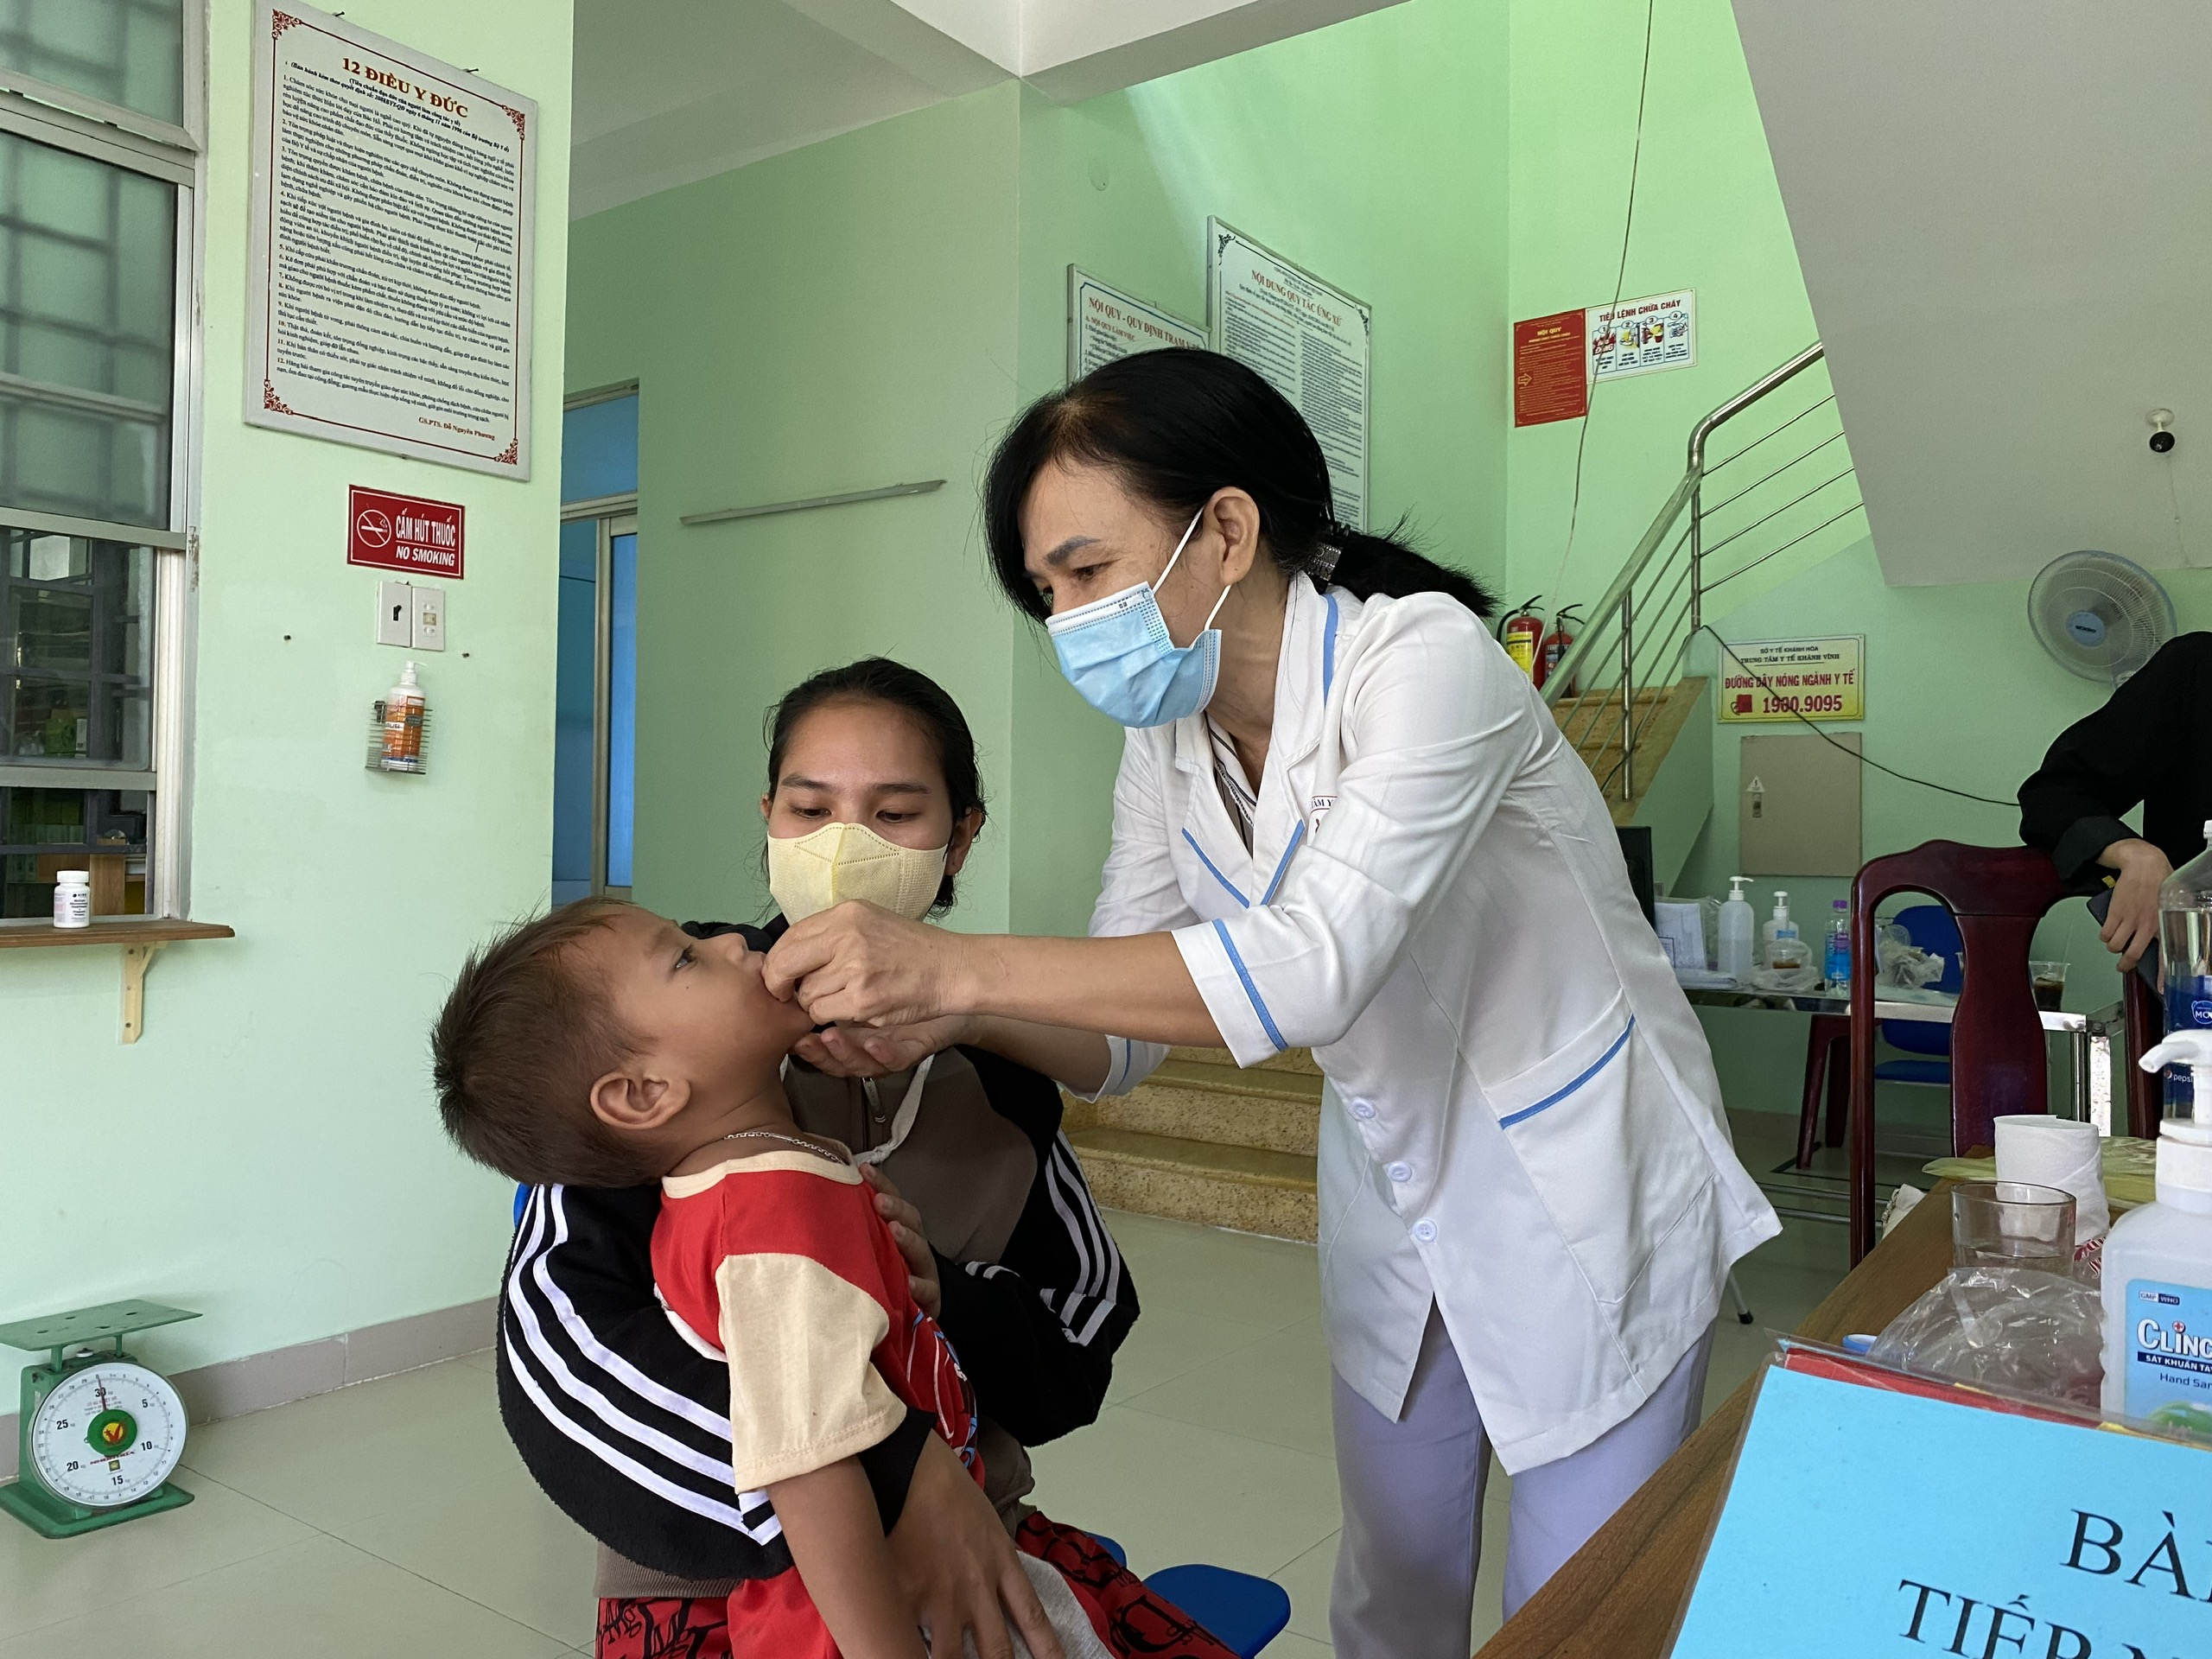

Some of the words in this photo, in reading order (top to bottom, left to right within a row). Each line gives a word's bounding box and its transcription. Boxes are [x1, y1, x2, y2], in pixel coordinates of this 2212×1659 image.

[342, 58, 359, 74] 12
[365, 67, 409, 92] ĐIỀU
[413, 86, 426, 100] Y
[429, 92, 467, 117] ĐỨC
[1267, 279, 1286, 296] DUNG
[1287, 290, 1300, 304] QUY
[1618, 308, 1636, 319] LỆNH
[1661, 300, 1681, 309] CHÁY
[1089, 297, 1103, 313] NỘI
[1106, 305, 1122, 321] QUY
[1127, 315, 1142, 330] QUY
[1144, 323, 1163, 337] ĐỊNH
[396, 508, 412, 540] CẤM
[415, 513, 429, 543] HÚT
[431, 515, 455, 547] THUỐC
[396, 545, 410, 560] NO
[412, 548, 454, 566] SMOKING
[1725, 674, 1753, 689] ĐƯỜNG
[1756, 673, 1773, 688] DÂY
[1776, 672, 1799, 687] NÓNG
[1802, 671, 1831, 686] NGÀNH
[1834, 674, 1840, 685] Y
[1843, 668, 1855, 684] TẾ
[1312, 798, 1325, 807] ÂM
[2173, 1073, 2194, 1084] pepsi
[2159, 1372, 2190, 1386] Hand
[94, 1387, 106, 1397] 30
[142, 1398, 148, 1408] 5
[56, 1419, 68, 1430] 25
[141, 1441, 153, 1451] 10
[67, 1461, 79, 1471] 20
[111, 1475, 124, 1486] 15
[2059, 1509, 2212, 1604] BÀ
